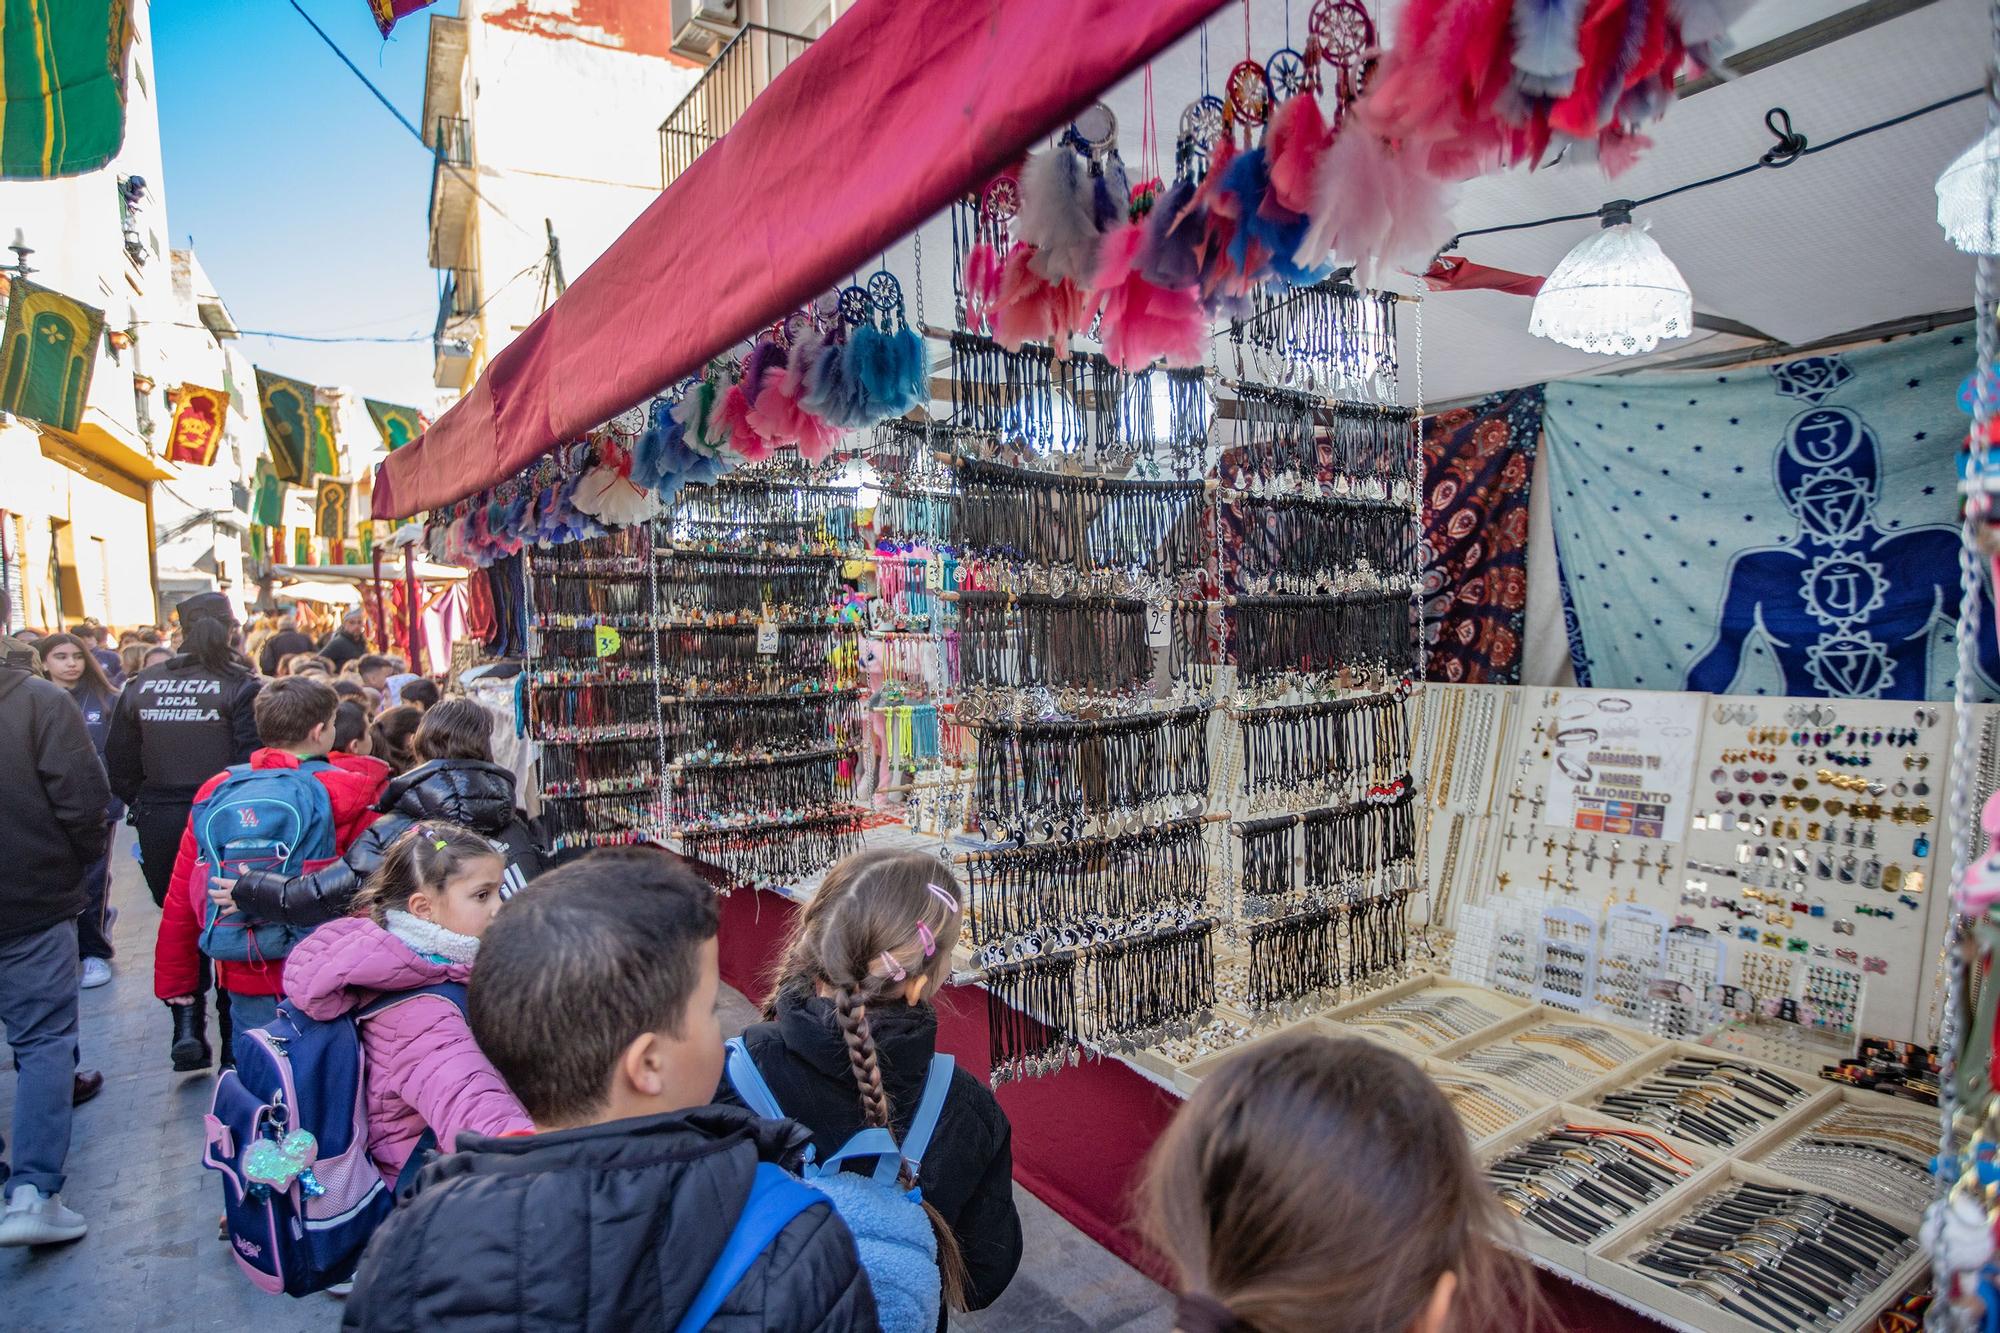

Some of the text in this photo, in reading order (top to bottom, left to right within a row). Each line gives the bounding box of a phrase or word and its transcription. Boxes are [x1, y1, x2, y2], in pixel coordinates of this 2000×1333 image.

[1150, 610, 1167, 634] 2€
[139, 679, 221, 694] POLICIA
[157, 696, 198, 707] LOCAL
[1587, 752, 1644, 768] GRABAMOS
[1599, 771, 1643, 788] NOMBRE
[1572, 785, 1672, 804] AL MOMENTO
